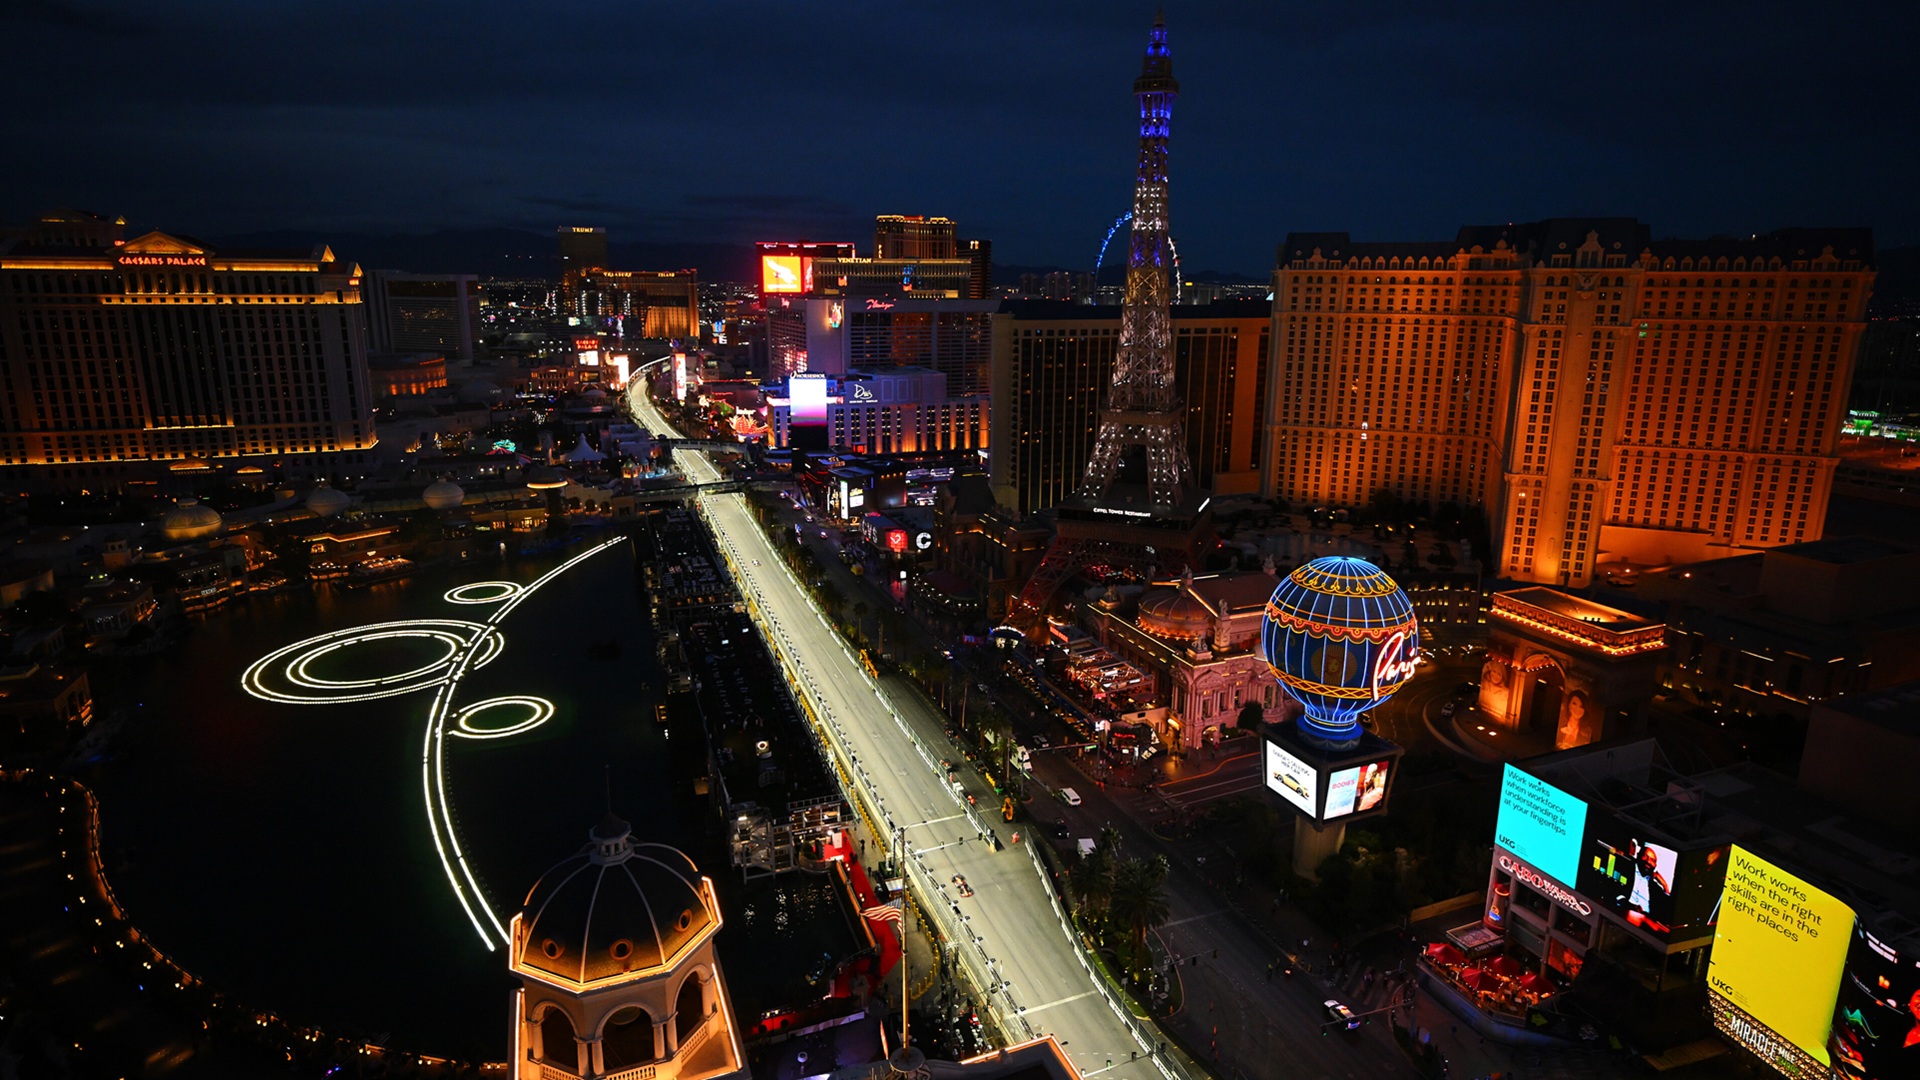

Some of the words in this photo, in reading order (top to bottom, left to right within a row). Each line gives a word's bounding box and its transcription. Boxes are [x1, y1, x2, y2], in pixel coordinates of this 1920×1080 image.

[118, 256, 164, 265] CAESARS
[166, 257, 206, 266] PALACE
[865, 299, 895, 310] Flamingo
[861, 518, 878, 544] CVS
[1373, 632, 1422, 702] Paris
[1332, 779, 1356, 790] BODIES
[1506, 780, 1527, 795] when
[1527, 791, 1566, 815] workforce
[1507, 769, 1527, 785] Work
[1527, 781, 1550, 797] works
[1504, 798, 1512, 807] at
[1512, 803, 1529, 815] your
[1530, 810, 1566, 836] fingertips
[1505, 789, 1559, 823] understanding
[1559, 815, 1566, 826] is
[1498, 833, 1516, 849] UKG
[1499, 856, 1543, 888] CABO
[1735, 855, 1767, 881] Work
[1769, 876, 1807, 902] works
[1730, 883, 1758, 904] skills
[1759, 900, 1780, 916] are
[1782, 909, 1794, 925] in
[1796, 919, 1819, 938] the
[1733, 870, 1765, 894] when
[1768, 889, 1789, 907] the
[1791, 903, 1822, 926] right
[1727, 895, 1755, 917] right
[1756, 913, 1799, 942] places
[1711, 976, 1734, 996] UKG
[1730, 1015, 1778, 1061] MIRACLE
[1777, 1055, 1801, 1077] SHOPS
[1778, 1045, 1797, 1065] MILE
